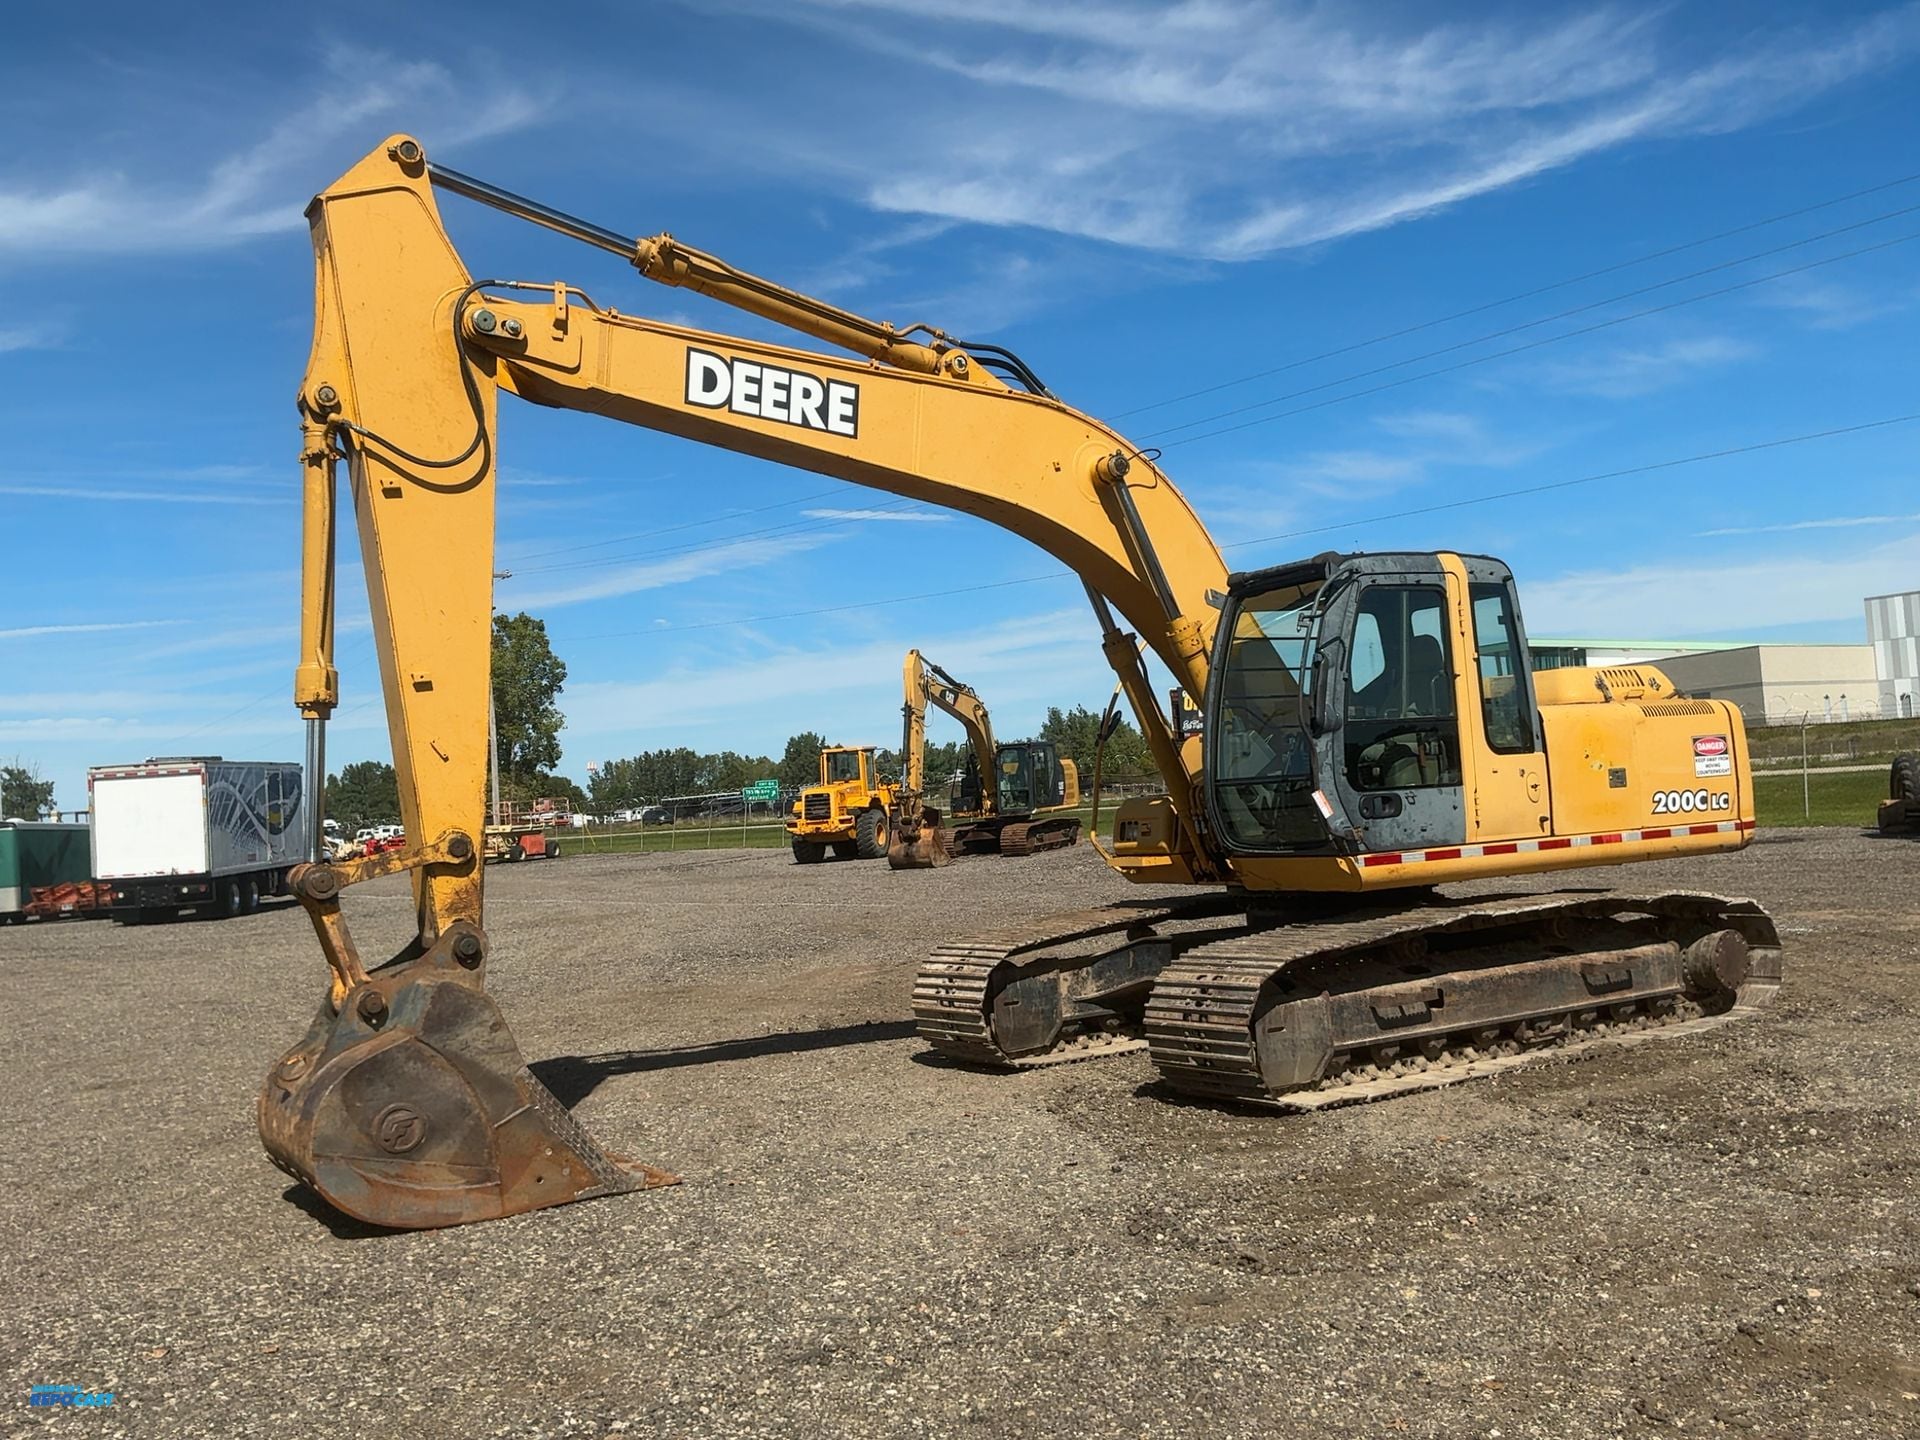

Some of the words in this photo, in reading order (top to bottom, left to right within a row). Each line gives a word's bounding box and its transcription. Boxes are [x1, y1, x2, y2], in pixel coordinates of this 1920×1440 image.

[685, 346, 859, 438] DEERE
[945, 690, 955, 705] CAT
[1696, 741, 1725, 751] DANGER
[1651, 788, 1709, 815] 200C
[1710, 792, 1729, 811] LC
